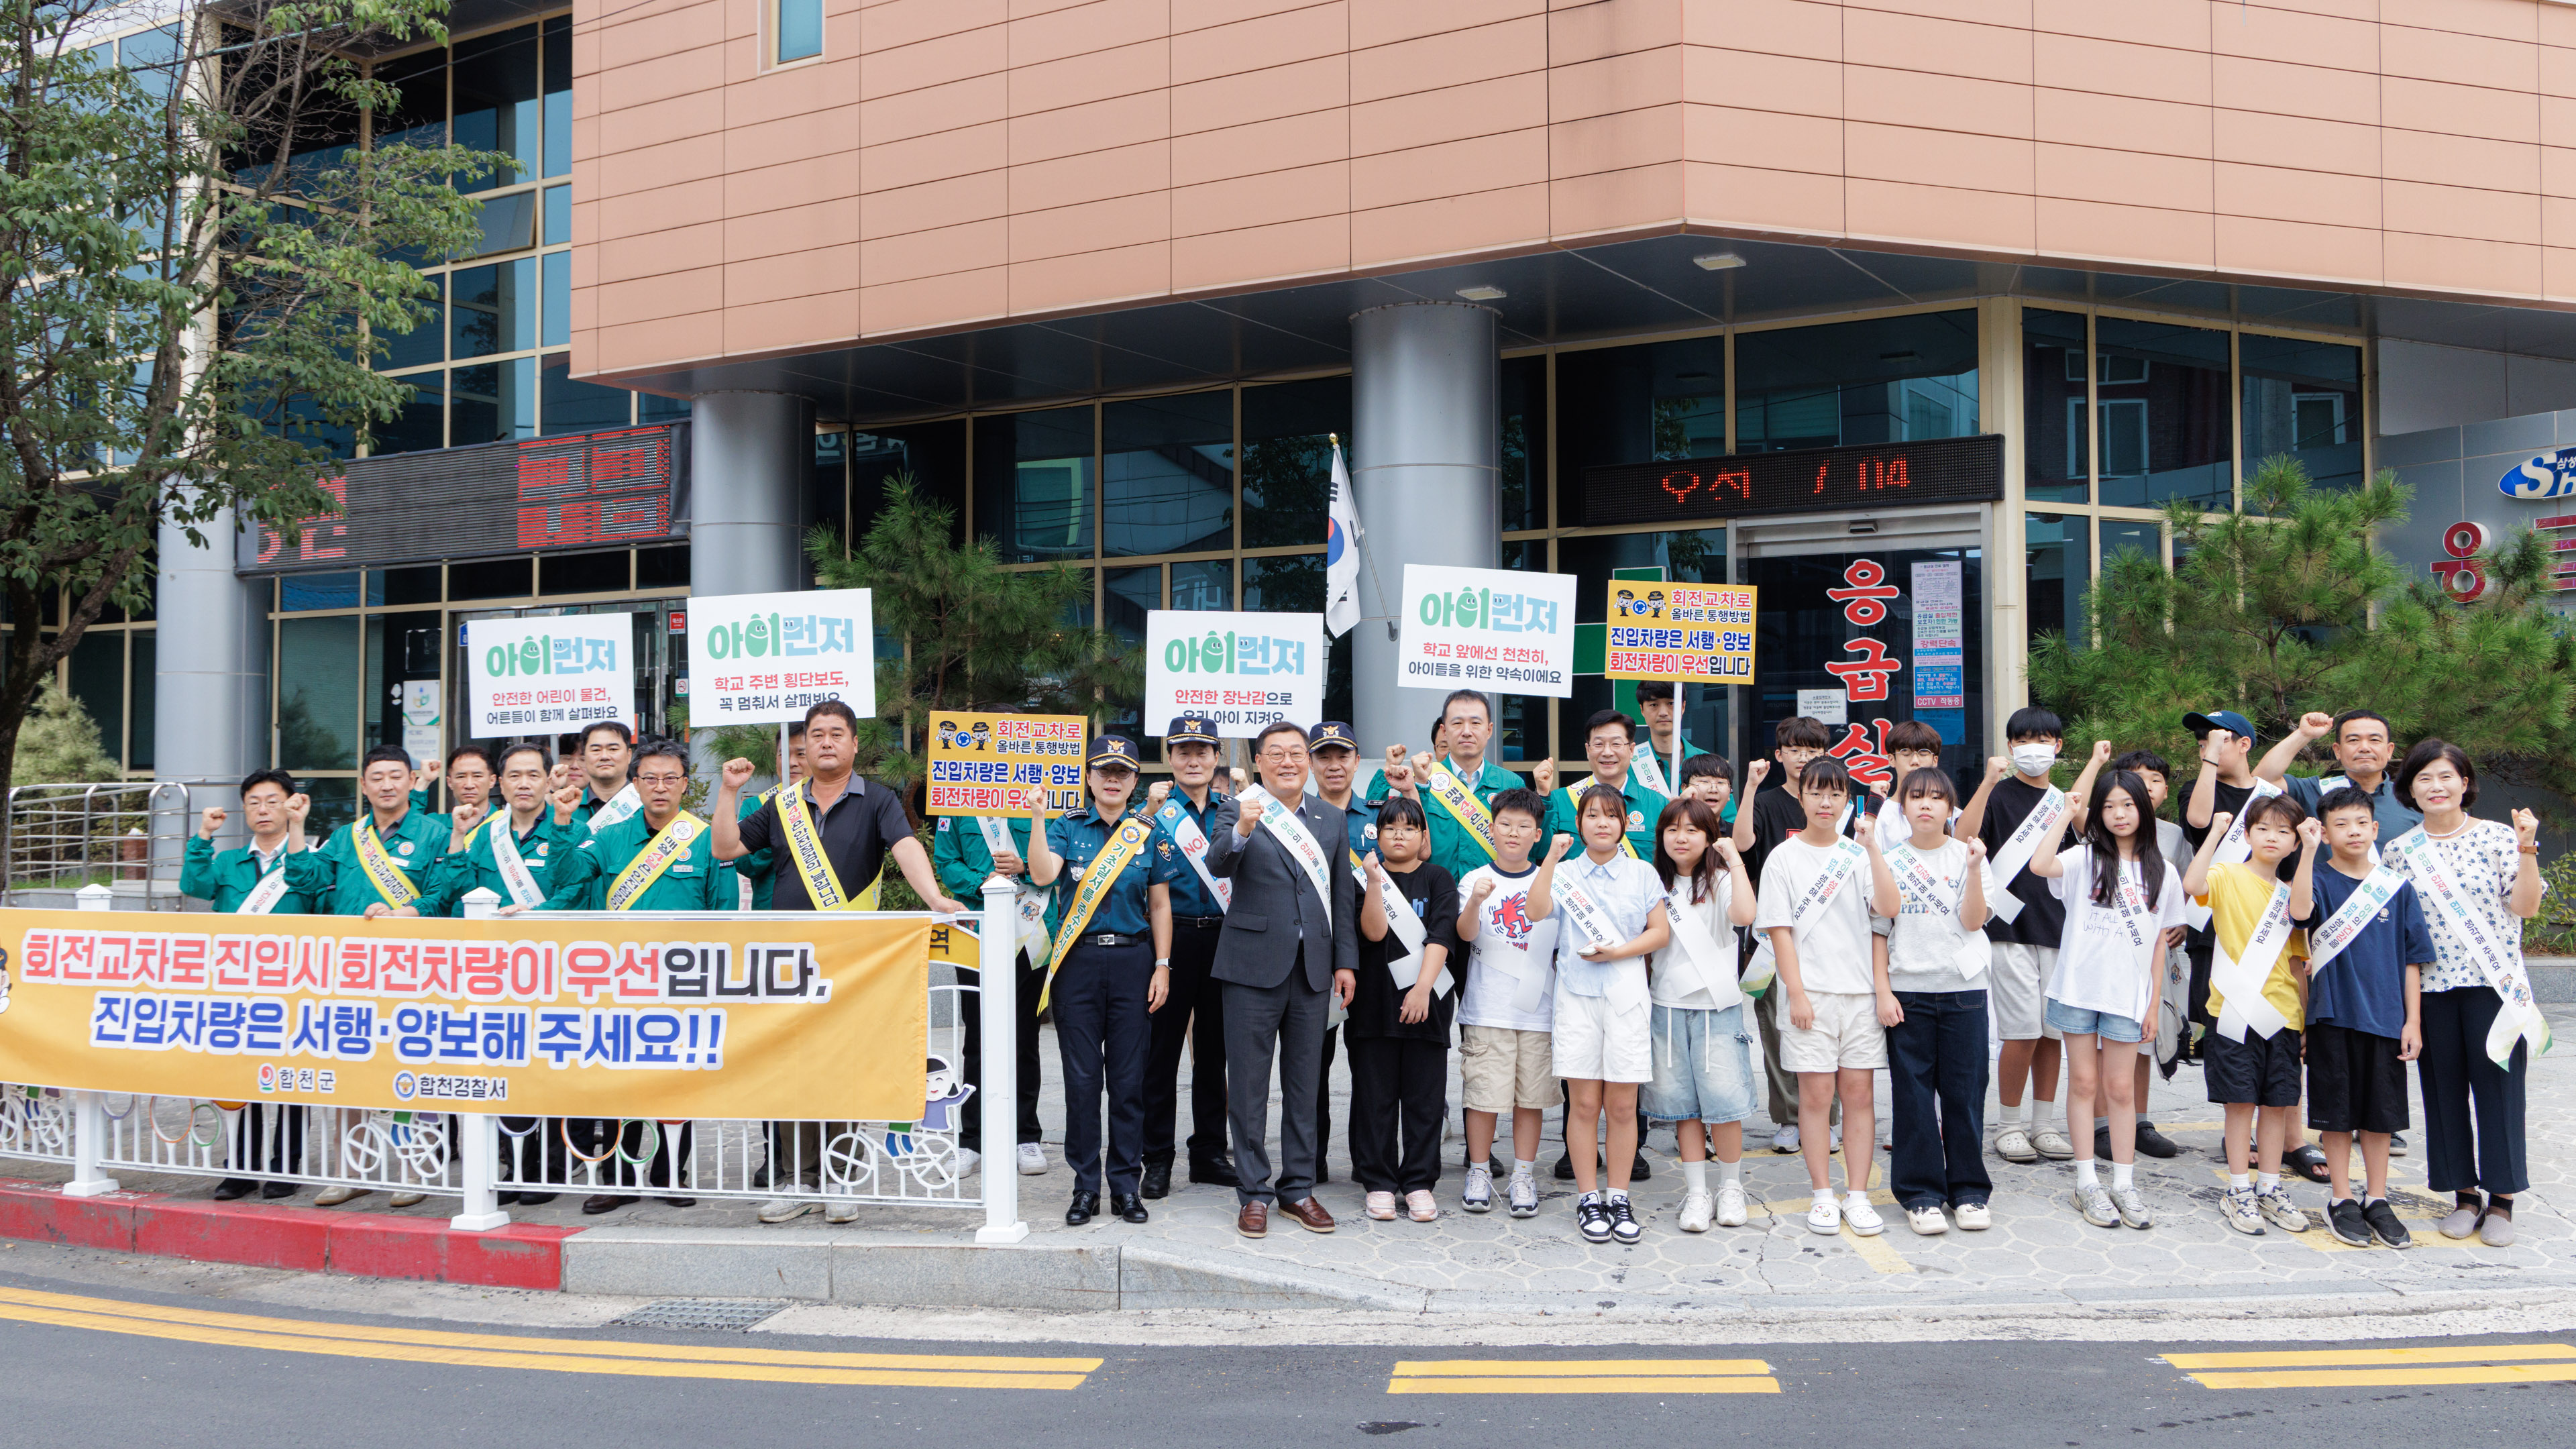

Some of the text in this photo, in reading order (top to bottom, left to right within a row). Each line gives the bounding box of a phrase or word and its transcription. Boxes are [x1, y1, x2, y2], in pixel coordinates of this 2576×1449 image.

[1419, 586, 1558, 634] 아이먼저
[1671, 589, 1752, 609] 회전교차로
[1670, 608, 1751, 624] 올바른 통행방법
[707, 612, 853, 660] 아이먼저
[1610, 627, 1751, 652] 진입차량은 서행·양보
[1921, 639, 1957, 649] 강력단속
[486, 634, 616, 678] 아이먼저
[1165, 631, 1305, 676] 아이먼저
[1423, 642, 1549, 666] 학교 앞에선 천천히,
[1609, 651, 1751, 676] 회전차량이 우선입니다
[714, 670, 849, 692] 학교 주변 횡단보도,
[1408, 661, 1562, 684] 아이들을 위한 약속이에요
[1825, 558, 1902, 786] 응급실
[492, 687, 611, 707] 안전한 어린이 물건,
[719, 697, 734, 712] 꼭
[738, 695, 780, 711] 멈춰서
[1175, 690, 1293, 706] 안전한 장난감으로
[1917, 697, 1960, 706] CCTV 작동중
[486, 706, 619, 725] 어른들이 함께 살펴봐요
[1214, 711, 1240, 724] 아이
[998, 720, 1081, 740] 회전교차로
[996, 740, 1081, 756] 올바른 통행방법
[932, 761, 1081, 786] 진입차량은 서행·양보
[1640, 761, 1655, 783] 아이의
[930, 787, 1004, 808] 회전차량이
[2031, 804, 2049, 824] 생각해
[1280, 820, 1303, 844] 아이의
[1299, 842, 1320, 868] 안전을
[2015, 822, 2035, 844] 주세요
[1183, 835, 1208, 857] NO!
[1898, 847, 1917, 865] 아이의
[793, 827, 822, 873] 안전점검의
[810, 868, 840, 908] 날입니다
[1794, 857, 1839, 921] 먼저 생각해 주세요
[1817, 857, 1853, 906] 아이의 성장을
[1893, 858, 1909, 874] 먼저
[1907, 871, 1929, 894] 생각해
[1926, 892, 1951, 916] 주세요
[1053, 842, 1128, 963] 기초질서를 준수합시다
[1565, 896, 1587, 920] 생각해
[1571, 890, 1595, 914] 안전을
[2123, 886, 2143, 915] 정서를
[2342, 902, 2359, 919] 먼저
[2417, 851, 2502, 972] 아이의 안전을 먼저 생각해 주세요
[2255, 886, 2288, 945] 먼저 생각해 주세요
[2351, 903, 2374, 926] 아이의
[2125, 920, 2143, 947] 주세요
[2320, 917, 2345, 941] 생각해
[25, 934, 827, 998] 회전교차로 진입시 회전차량이 우선입니다.
[95, 997, 722, 1065] 진입차량은 서행·양보해 주세요!!
[419, 1077, 506, 1099] 합천경찰서
